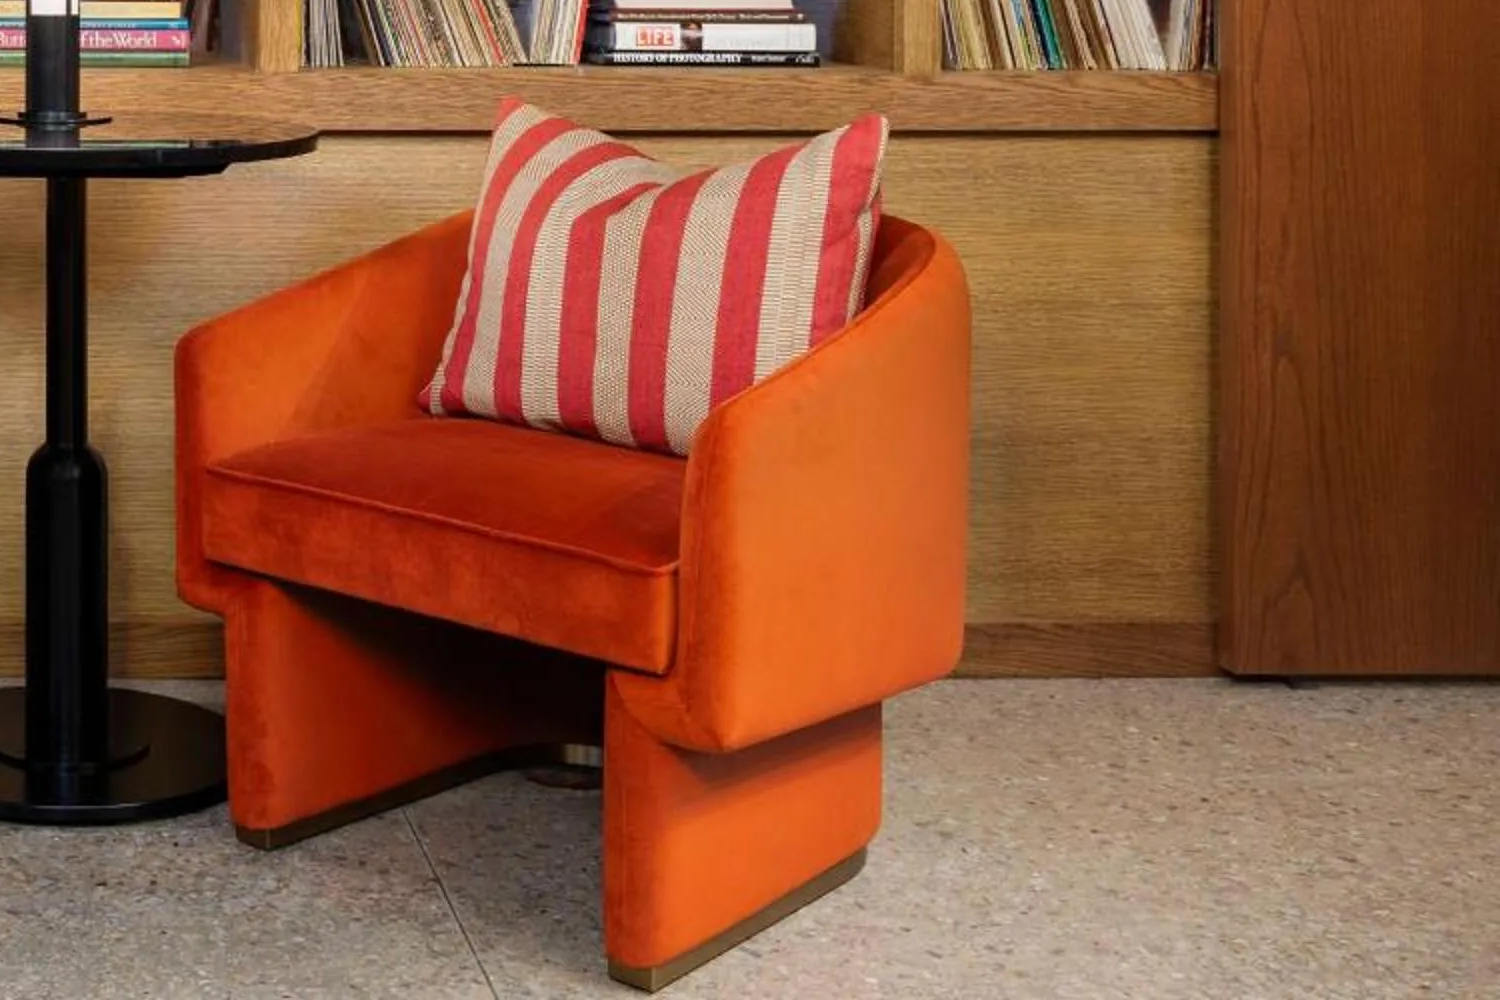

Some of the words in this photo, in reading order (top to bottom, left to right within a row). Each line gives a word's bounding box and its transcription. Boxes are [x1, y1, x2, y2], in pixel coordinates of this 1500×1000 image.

[111, 30, 157, 48] World
[637, 28, 674, 46] LIFE
[613, 52, 654, 63] HISTORY
[655, 52, 668, 63] OF
[669, 52, 743, 63] PHOTOGRAPHY
